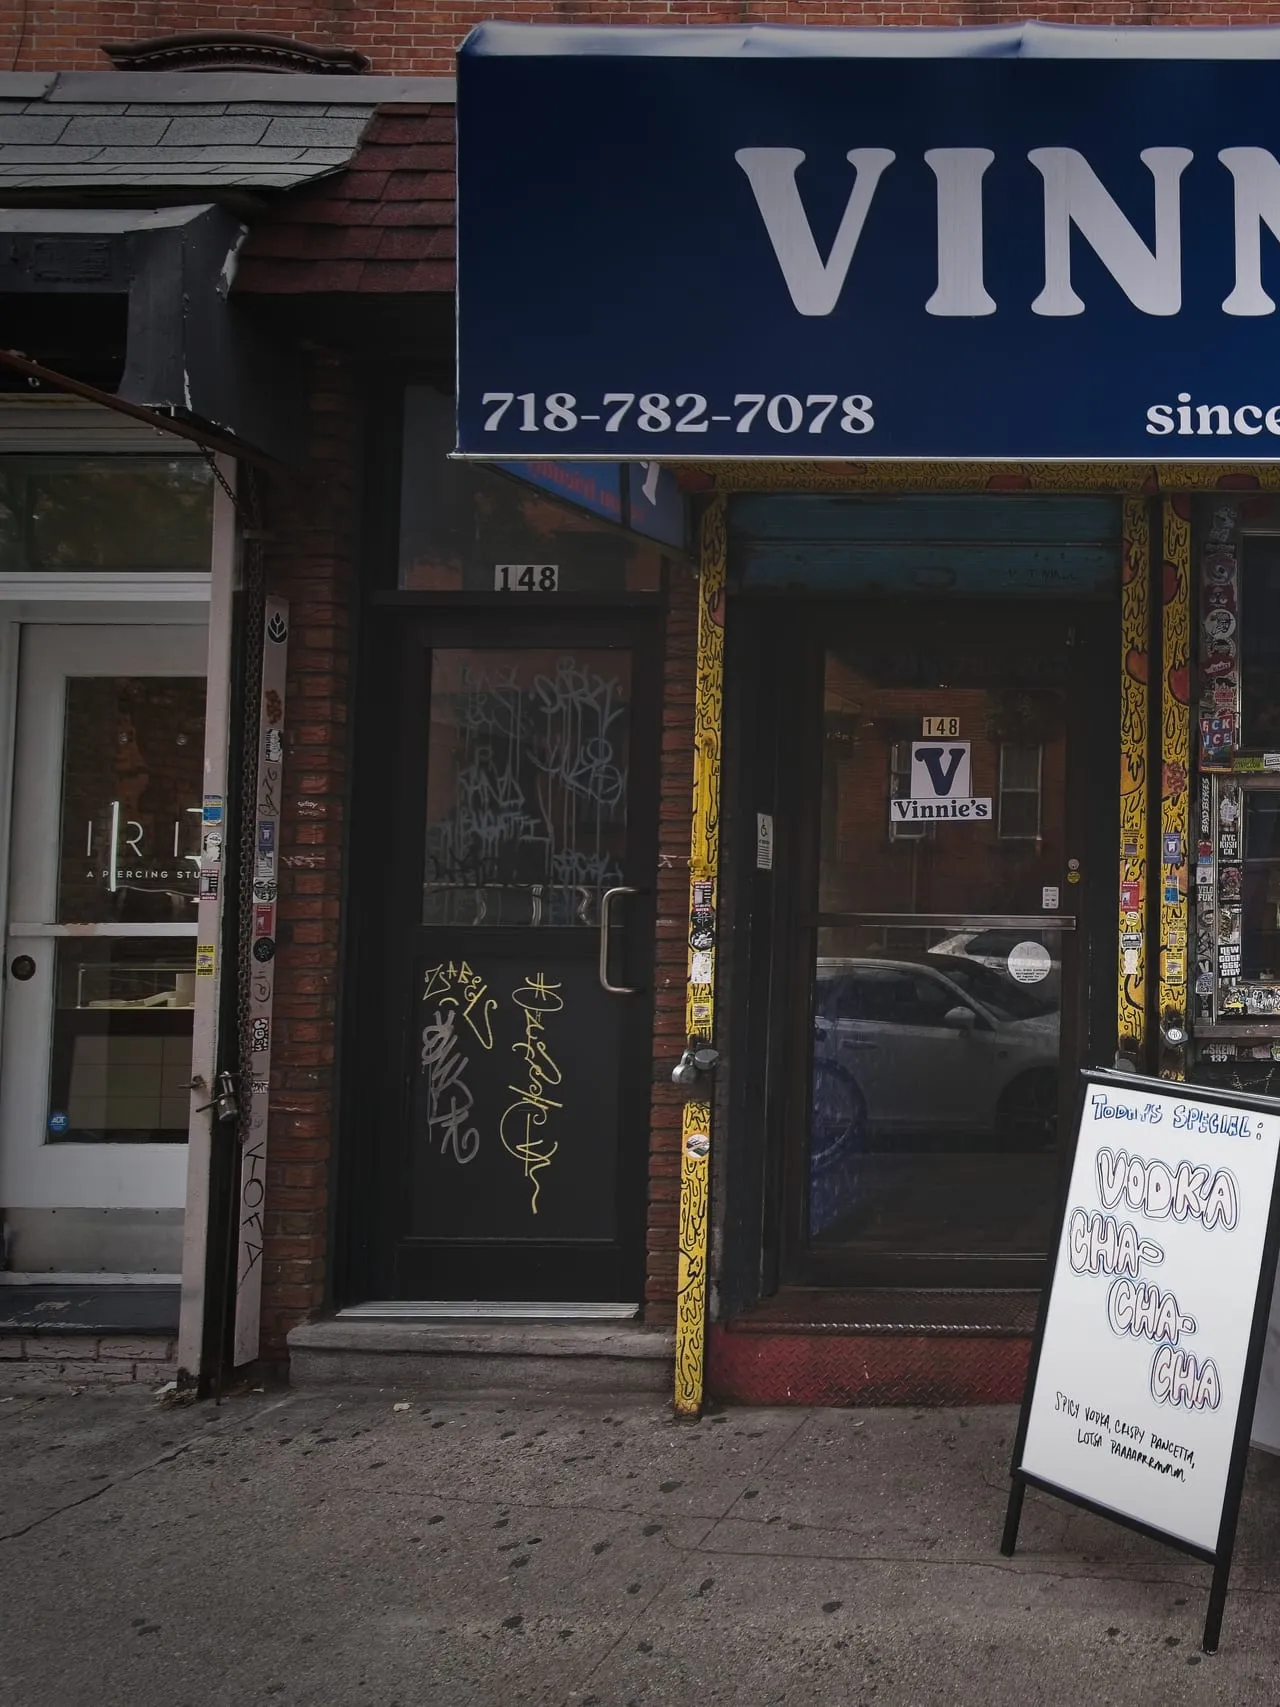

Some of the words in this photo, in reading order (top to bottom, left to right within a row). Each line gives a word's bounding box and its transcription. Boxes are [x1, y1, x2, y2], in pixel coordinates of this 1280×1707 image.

[482, 391, 875, 435] 718-782-7078
[499, 566, 556, 591] 148
[924, 718, 958, 735] 148
[914, 747, 966, 797] V
[893, 799, 988, 819] Vinnie's
[86, 870, 94, 879] A
[103, 870, 169, 880] PERCING
[1096, 1147, 1240, 1232] VODKA
[1148, 1343, 1222, 1411] CHA
[1055, 1391, 1080, 1419] SPICY
[1114, 1419, 1146, 1444] CRISPY
[1077, 1428, 1103, 1447] LOTSA
